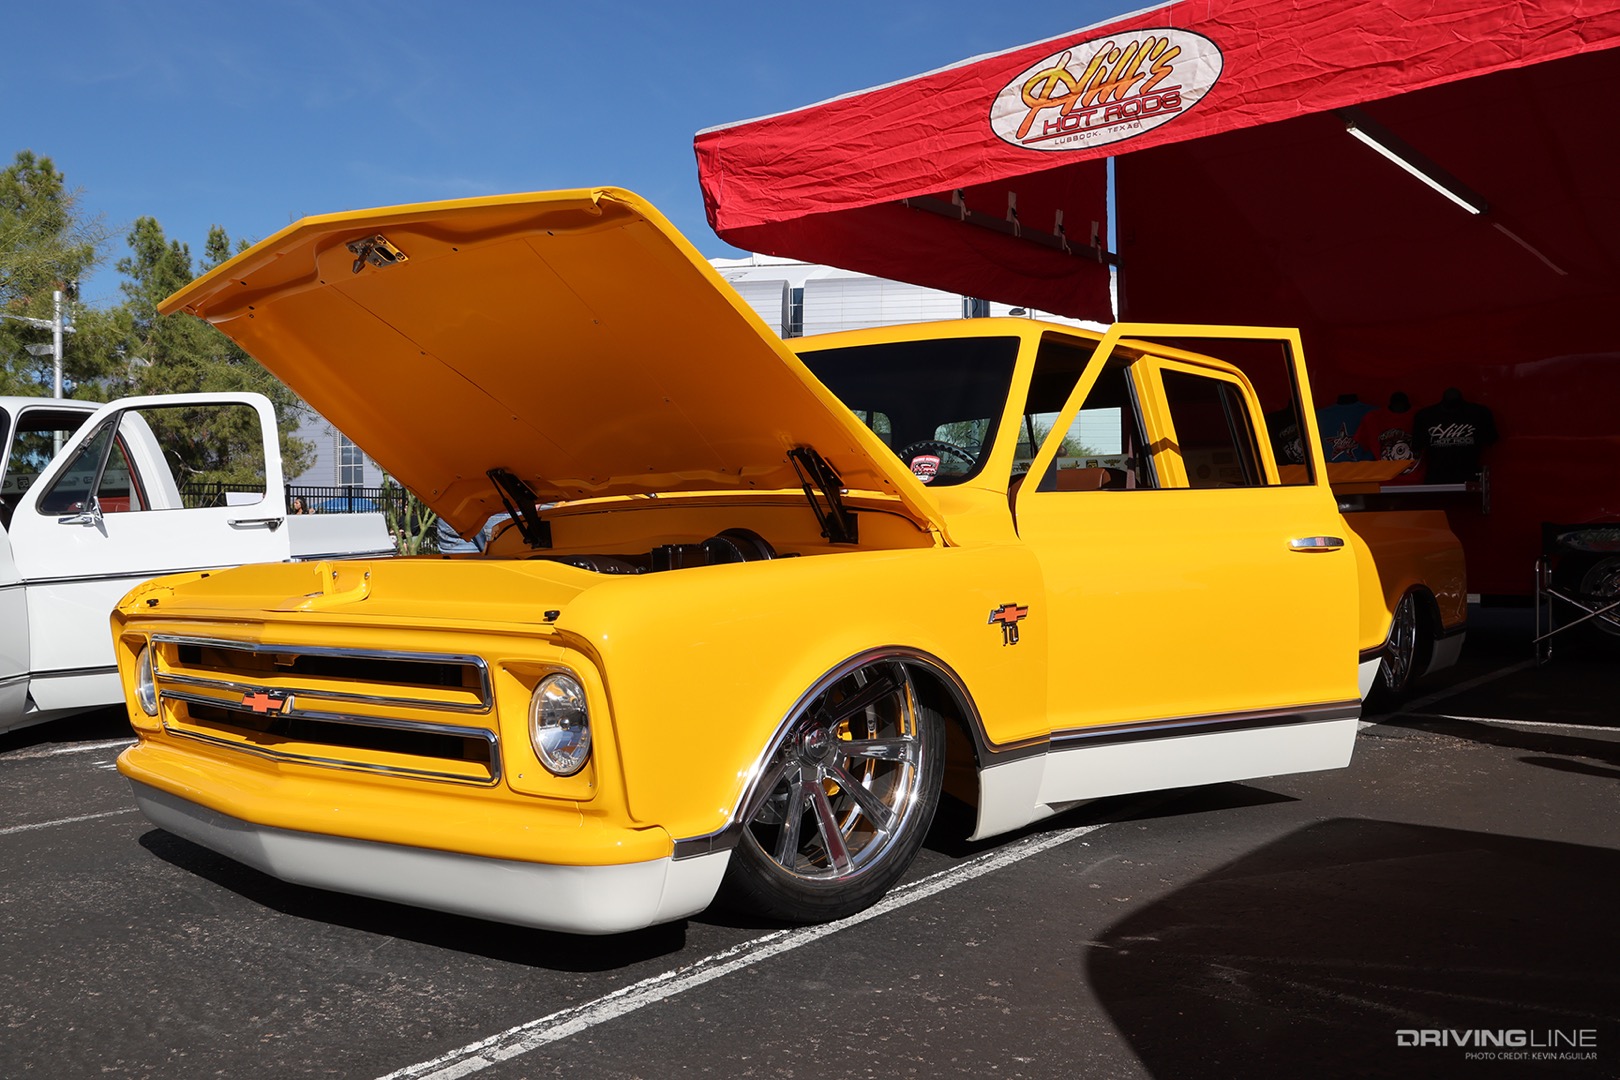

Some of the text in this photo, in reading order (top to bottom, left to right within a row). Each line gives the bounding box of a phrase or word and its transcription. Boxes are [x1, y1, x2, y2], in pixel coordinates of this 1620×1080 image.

[1016, 36, 1181, 139] Hill's
[1043, 91, 1181, 135] HOT RODS
[1107, 122, 1140, 134] TEXAS
